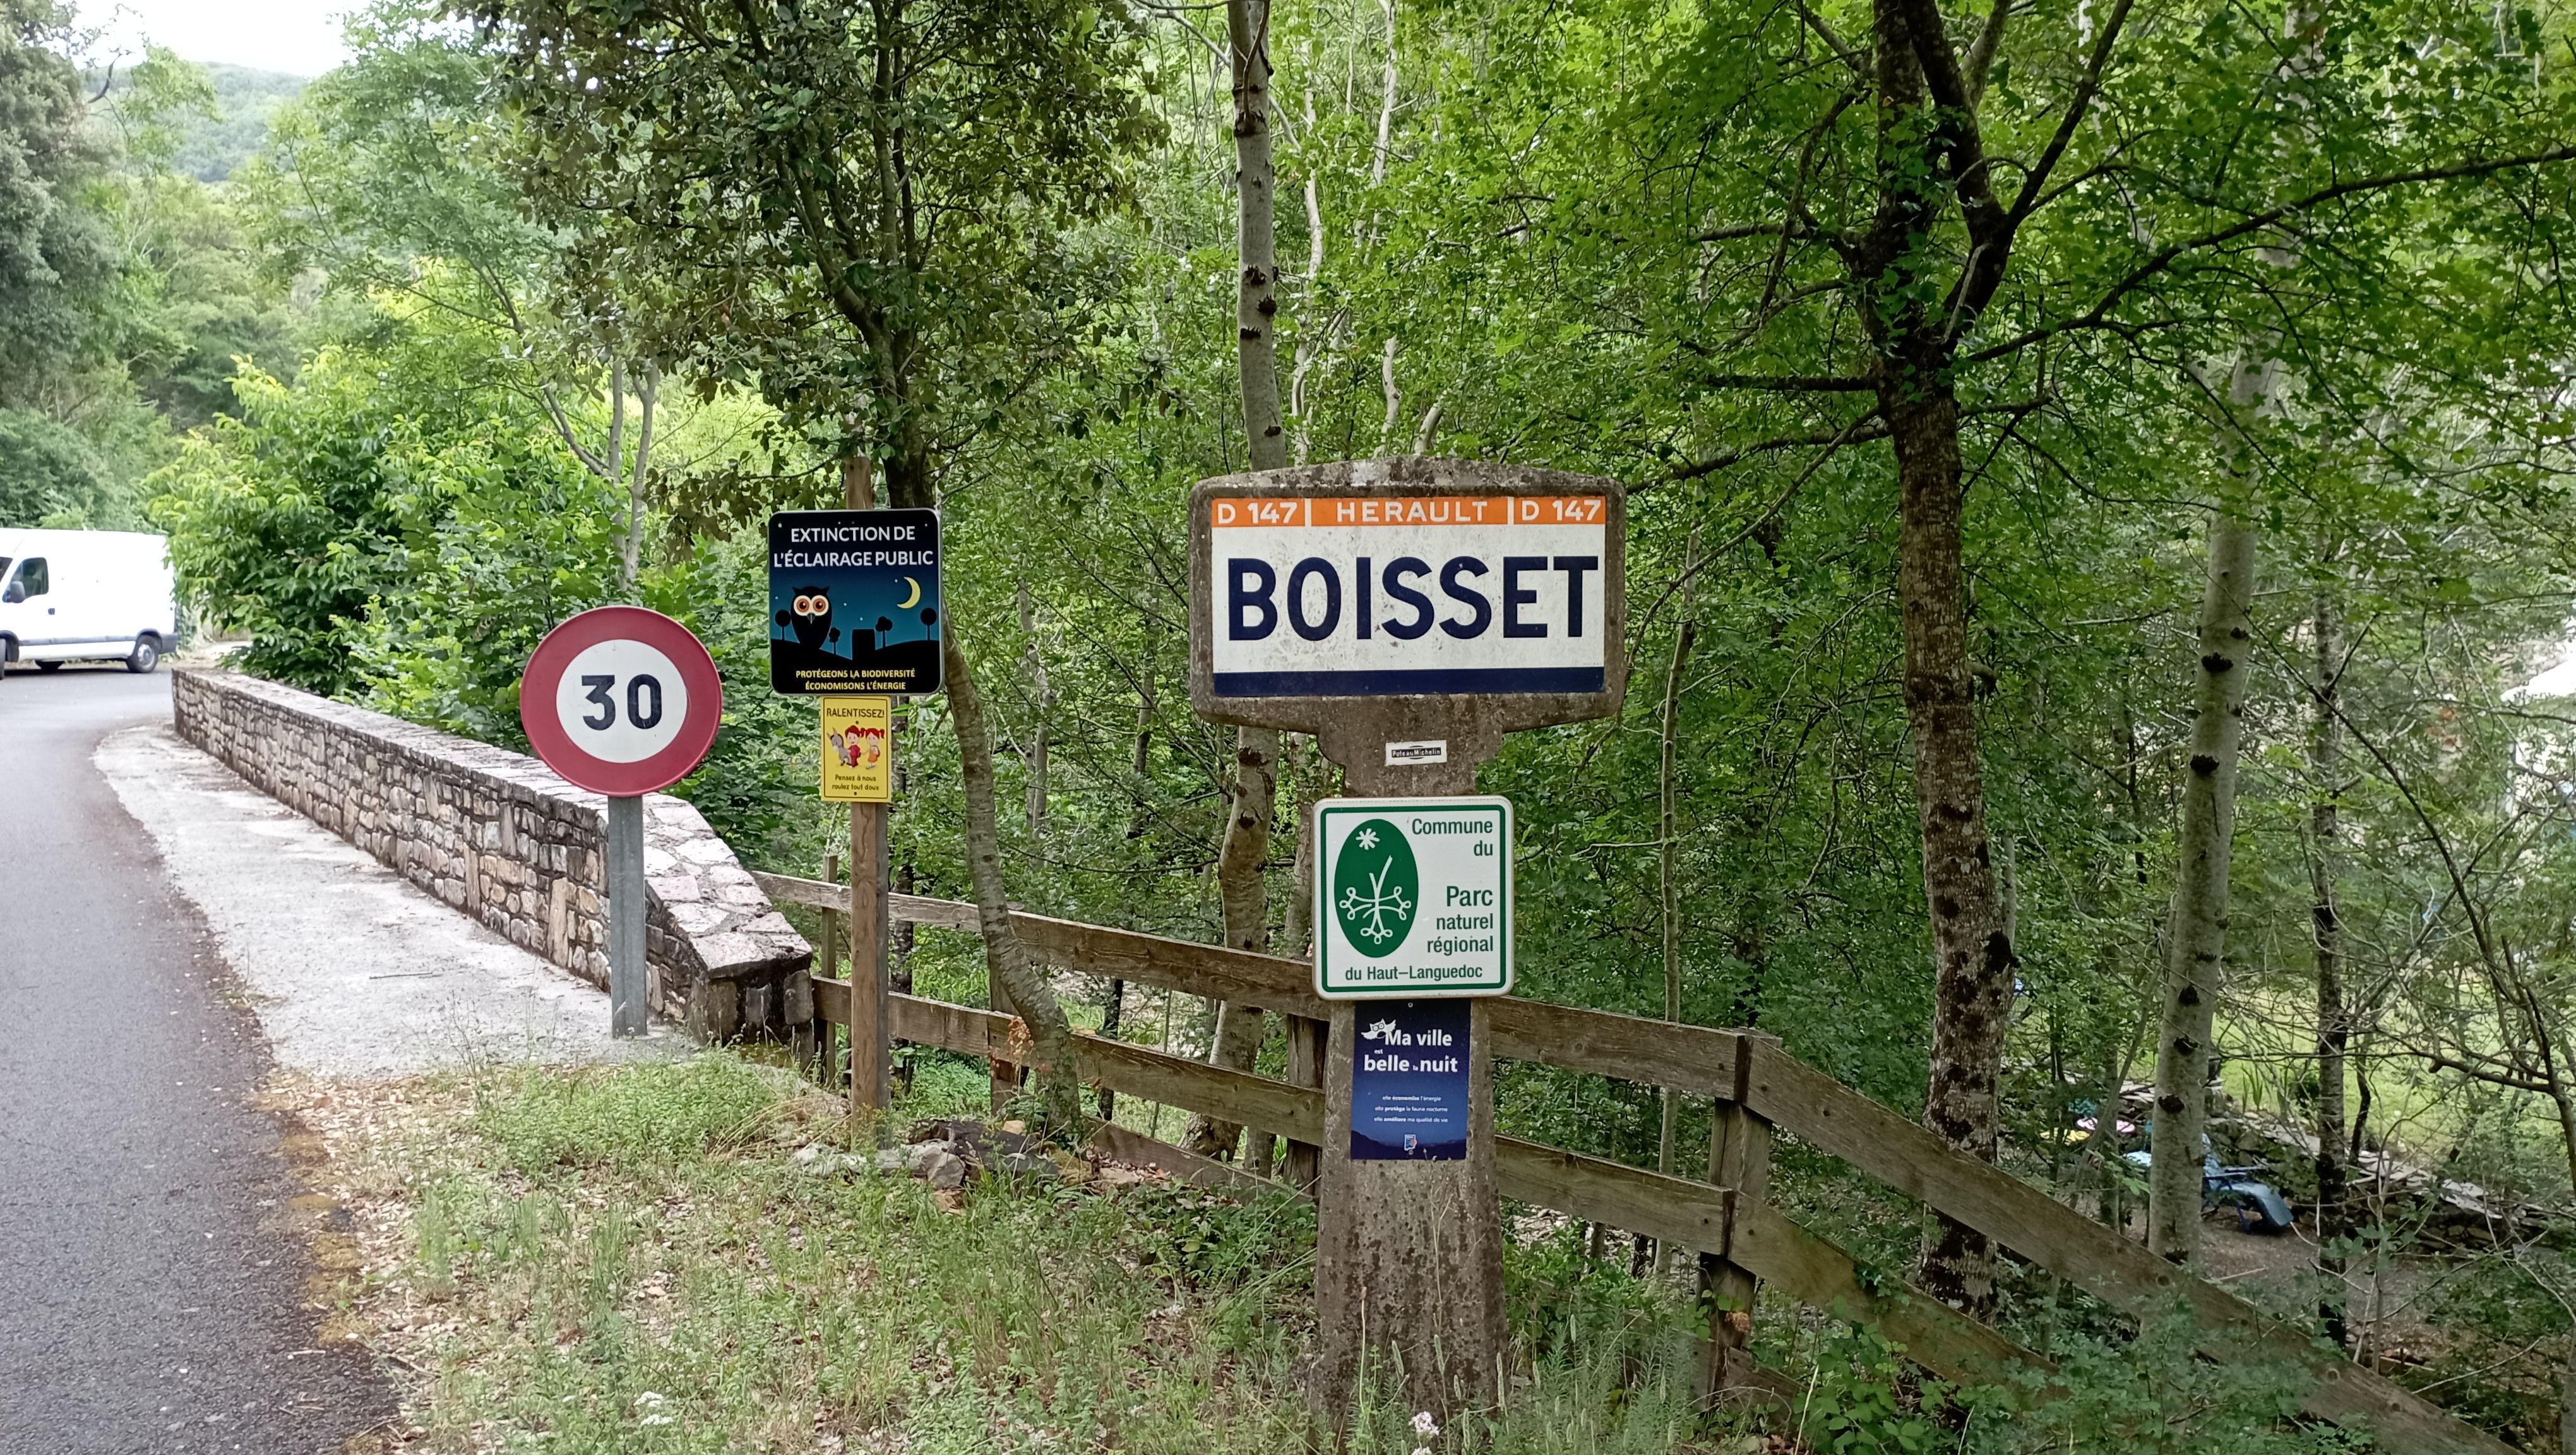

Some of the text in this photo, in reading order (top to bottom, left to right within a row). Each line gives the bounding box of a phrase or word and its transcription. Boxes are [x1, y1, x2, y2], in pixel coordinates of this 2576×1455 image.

[1218, 502, 1298, 524] D 147
[1337, 501, 1488, 523] HERAULT
[1521, 499, 1601, 522] D 147
[791, 525, 915, 542] EXTINCTION DE
[773, 549, 934, 568] L'ÉCLAIRAGE PUBLIC
[1227, 555, 1599, 642] BOISSET
[796, 668, 848, 678] PROTÉGEONS
[861, 668, 915, 678] BIODIVERSITÉ
[805, 680, 906, 690] ÉCONOMISONS L'ÉNERGIE
[581, 673, 662, 731] 30
[1412, 818, 1493, 835] Commune
[1473, 840, 1493, 856] du
[1446, 885, 1493, 907] Parc
[1436, 914, 1493, 930] naturel
[1427, 936, 1493, 955] régional
[1345, 967, 1362, 980] du
[1385, 1029, 1452, 1046] Ma ville
[1364, 1054, 1410, 1072] belle
[1420, 1055, 1458, 1072] nuit
